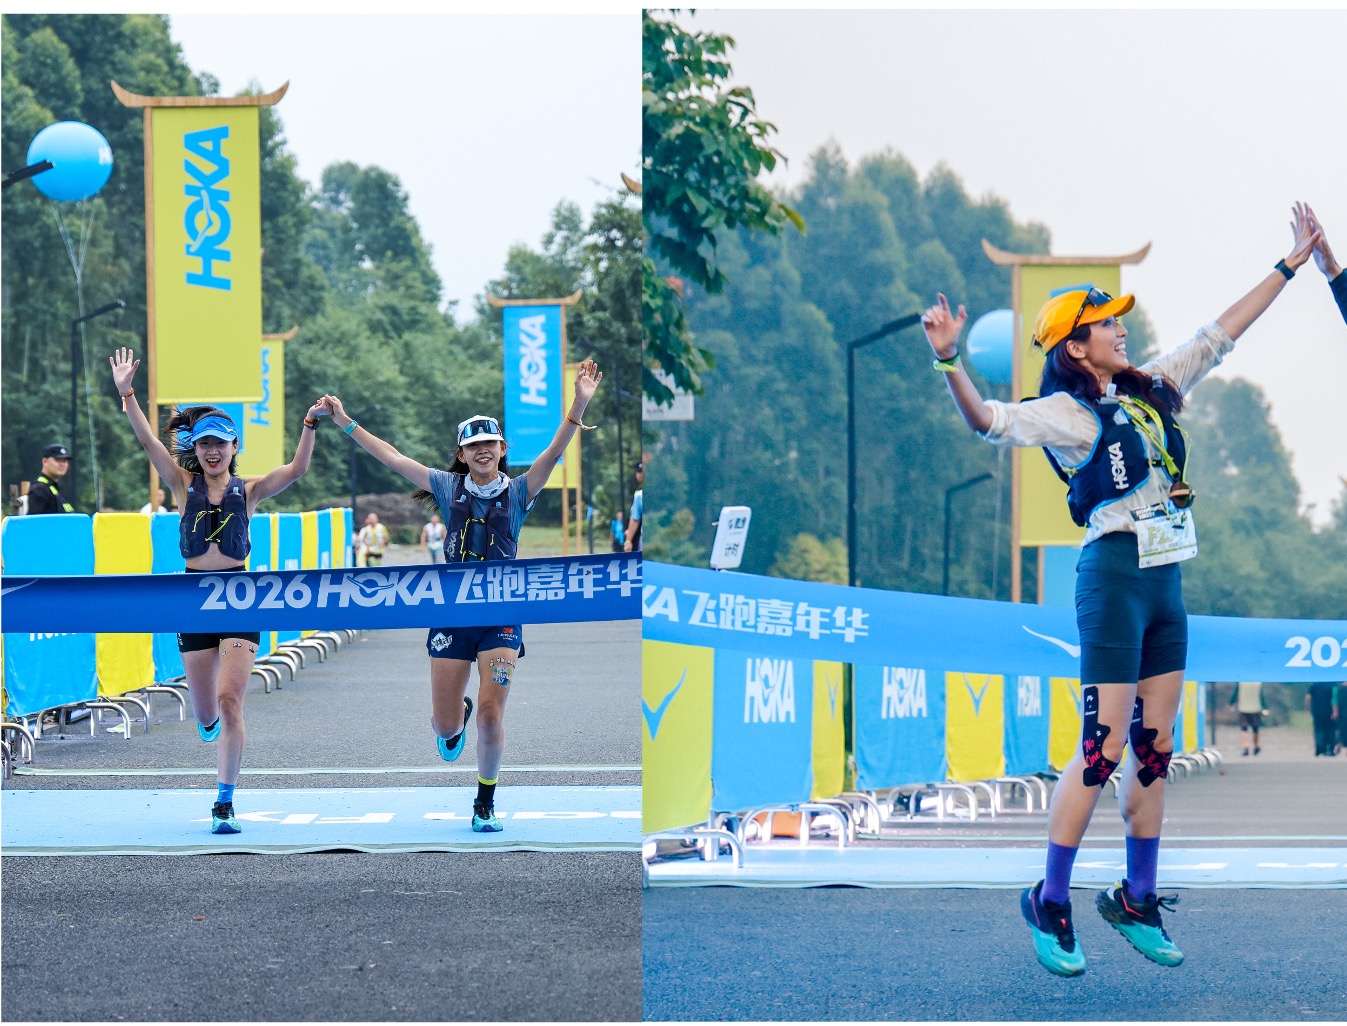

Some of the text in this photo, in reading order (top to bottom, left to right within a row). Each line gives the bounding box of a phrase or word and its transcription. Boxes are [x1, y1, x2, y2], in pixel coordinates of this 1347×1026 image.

[183, 125, 232, 291] HOKA
[519, 314, 547, 406] HOKA
[1107, 441, 1130, 490] HOKA
[198, 560, 642, 610] 2026 HOKA 飞跑嘉年华
[682, 589, 870, 643] 飞跑嘉年华
[744, 657, 796, 724] HOKA
[881, 667, 929, 719] HOKA
[1017, 677, 1042, 717] HOKA
